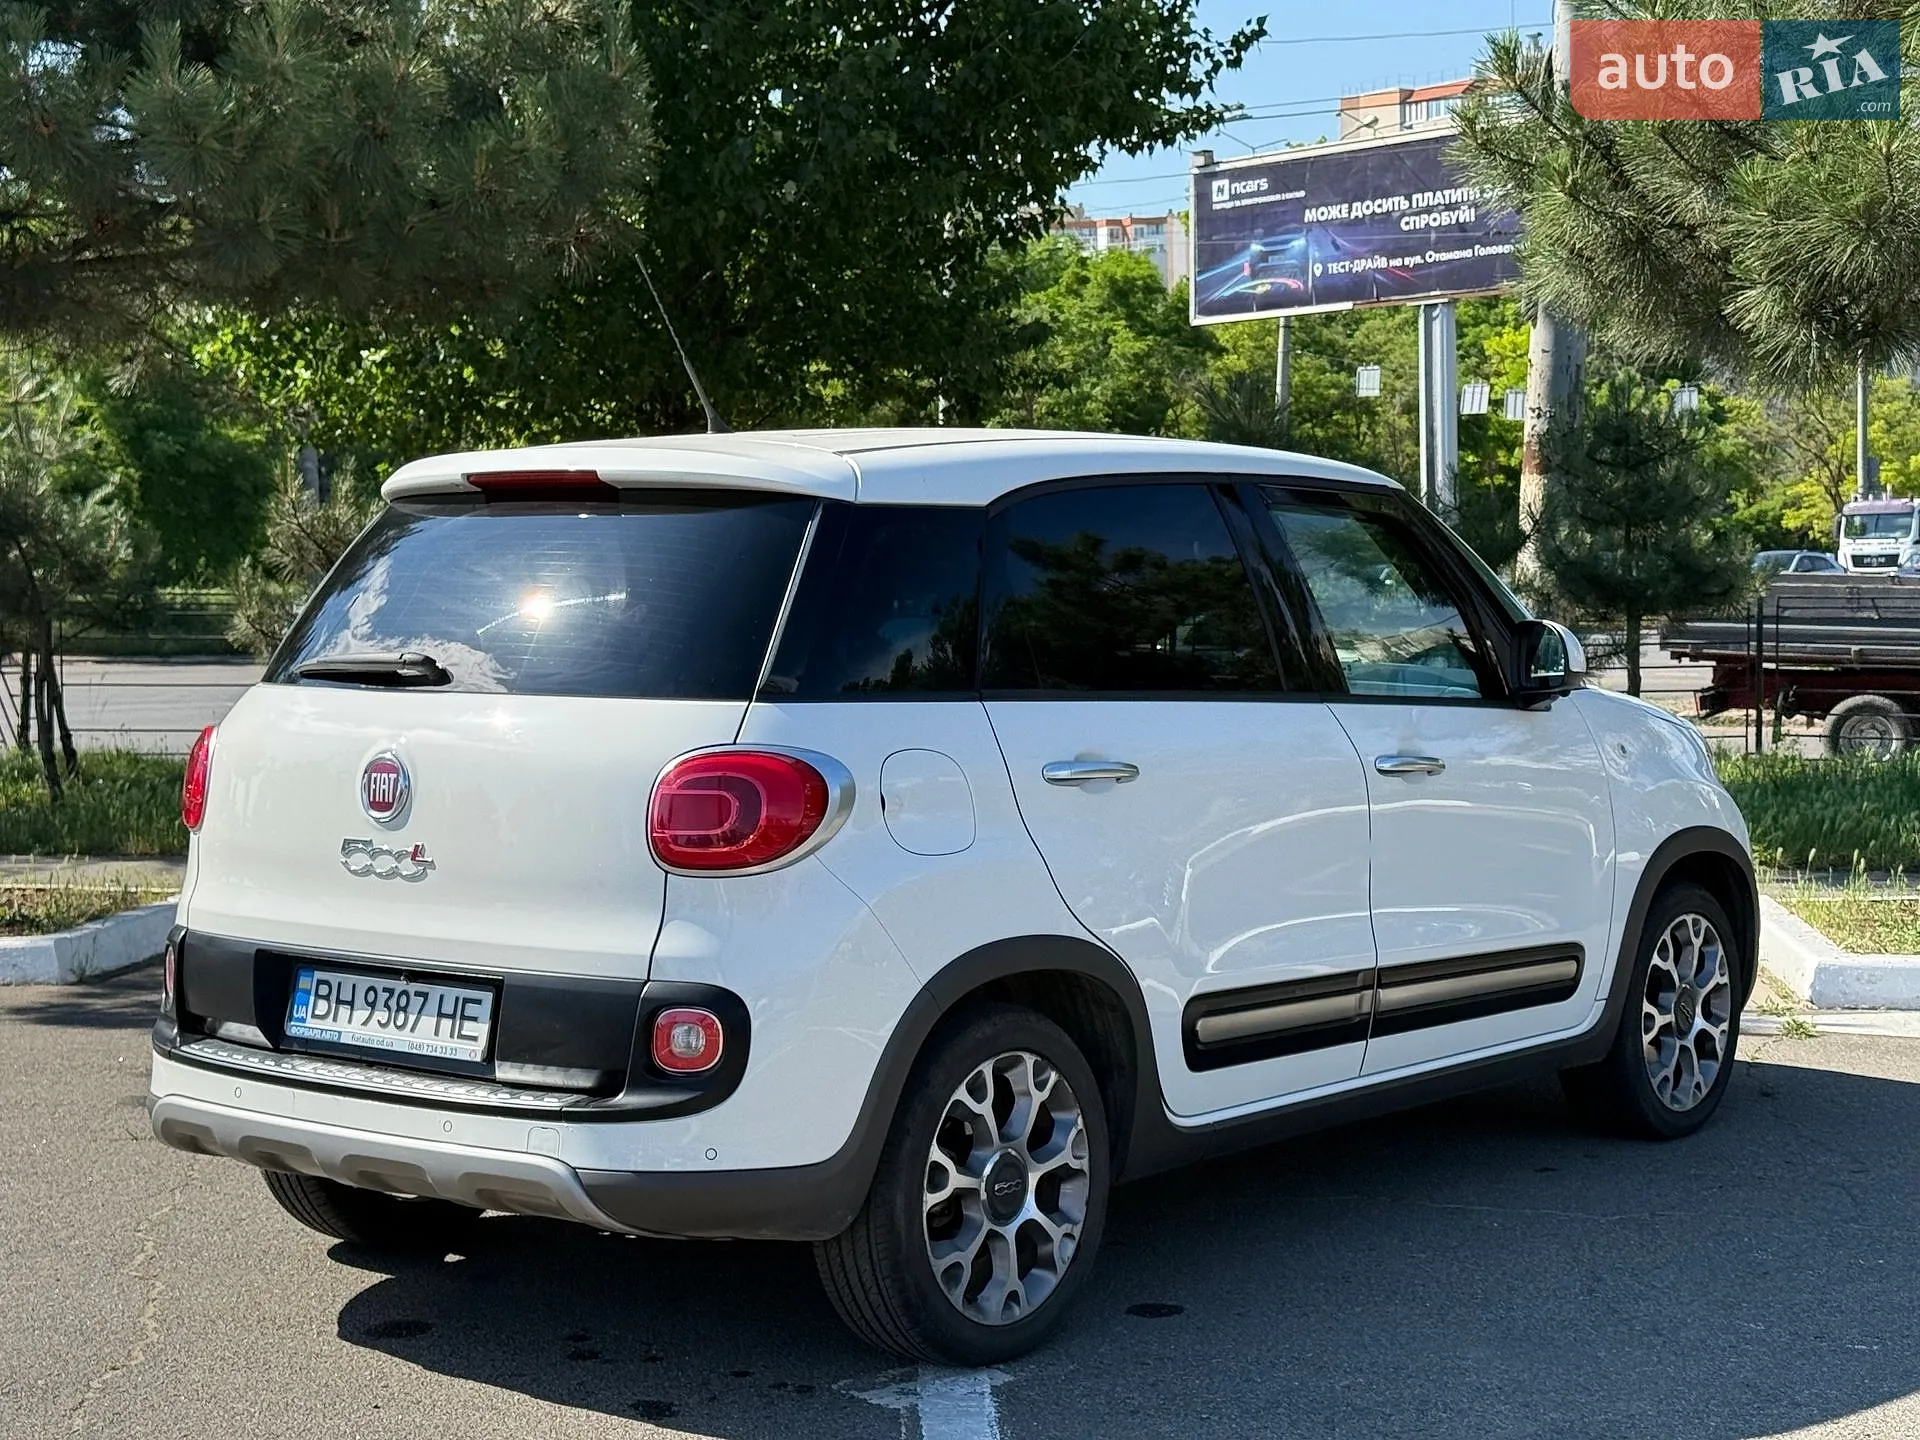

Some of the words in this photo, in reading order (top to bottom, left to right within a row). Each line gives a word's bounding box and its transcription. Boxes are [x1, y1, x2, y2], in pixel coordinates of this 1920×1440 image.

[1230, 177, 1269, 195] ncars
[1303, 203, 1349, 223] МОЖЕ
[1350, 194, 1410, 219] ДОСИТЬ
[1400, 205, 1476, 231] СПРОБУЙ!
[1327, 255, 1388, 274] ТЕСТ-ДРАЙВ
[1388, 257, 1403, 267] на
[1403, 255, 1425, 268] вул.
[1425, 250, 1473, 263] Отамана
[370, 773, 397, 803] FIAT
[293, 1005, 307, 1020] UA
[310, 978, 357, 1026] BH
[361, 985, 429, 1033] 9387
[433, 993, 482, 1042] HE
[321, 1030, 339, 1041] АВТО
